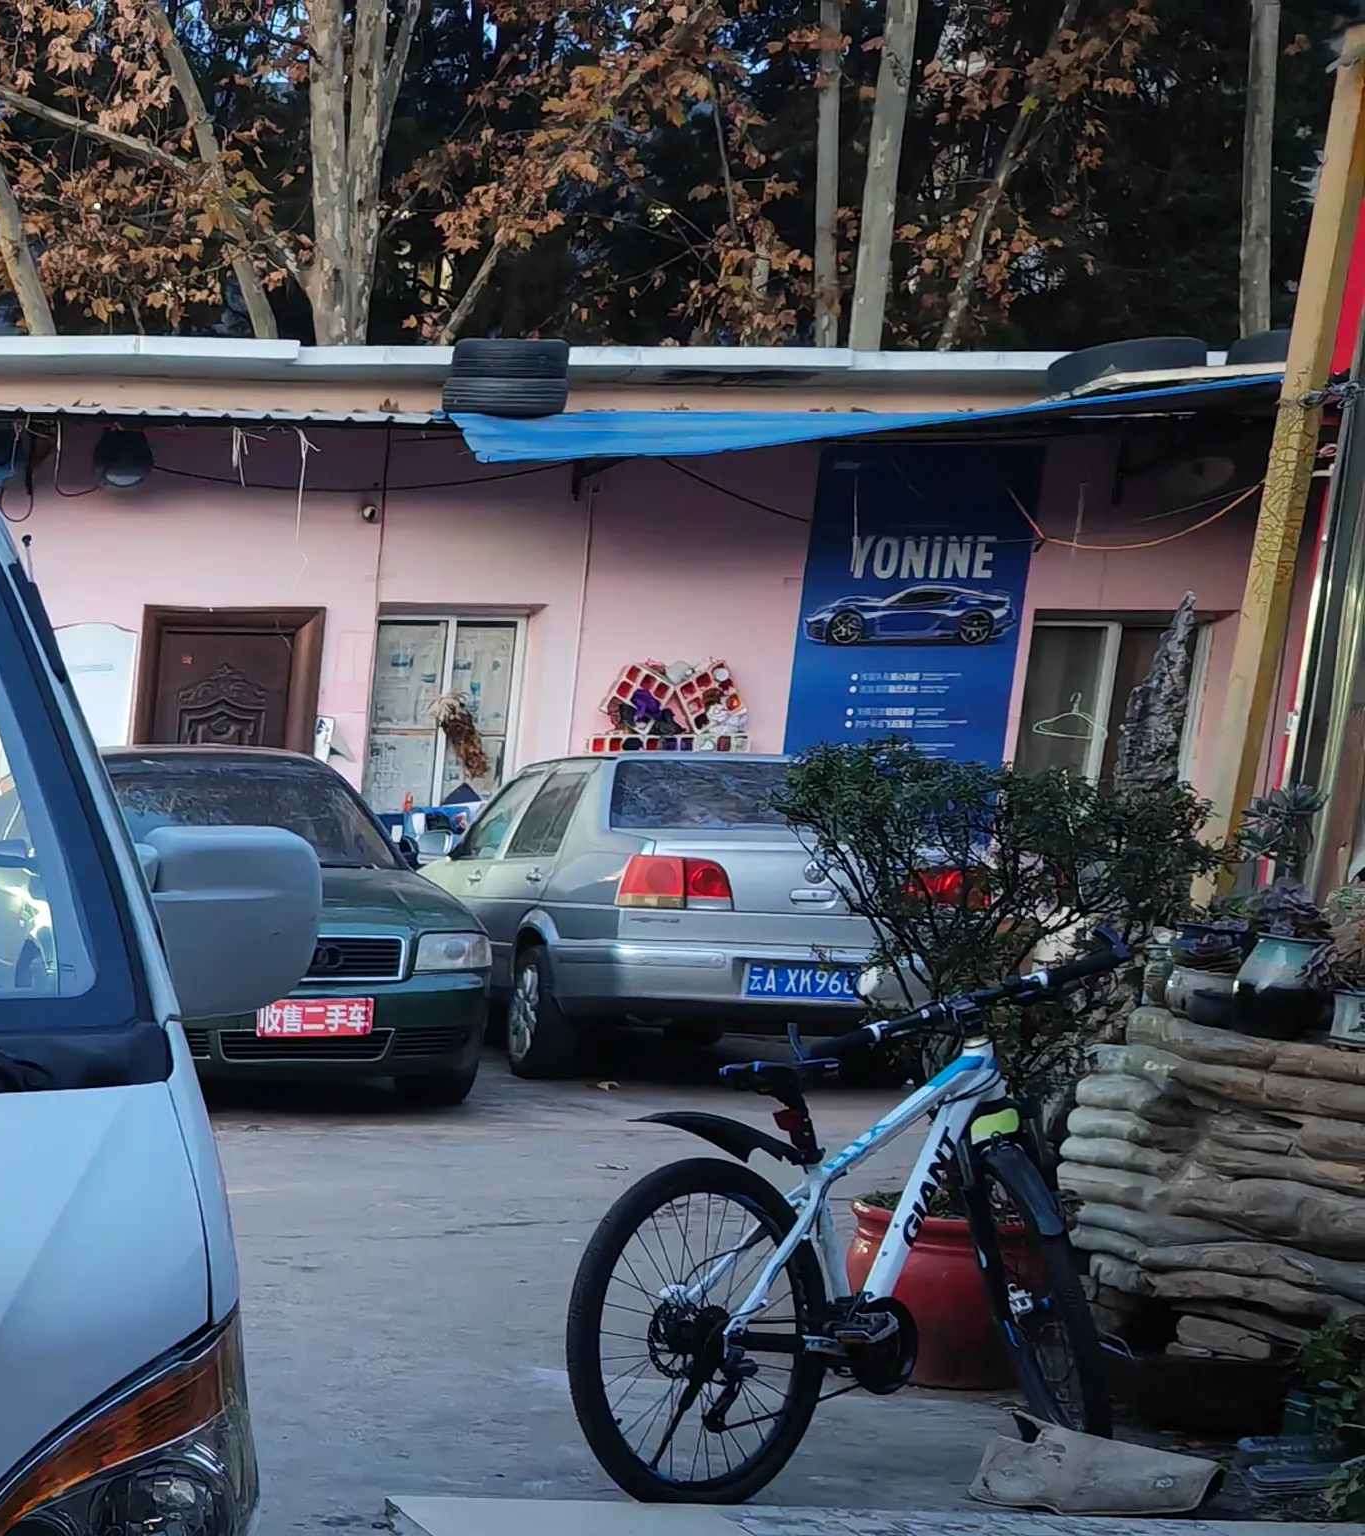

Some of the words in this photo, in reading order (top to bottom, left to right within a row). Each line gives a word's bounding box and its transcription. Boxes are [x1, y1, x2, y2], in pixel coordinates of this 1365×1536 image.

[852, 535, 998, 579] YONINE
[259, 1003, 370, 1034] 收售二手车
[902, 1125, 957, 1248] GIANT
